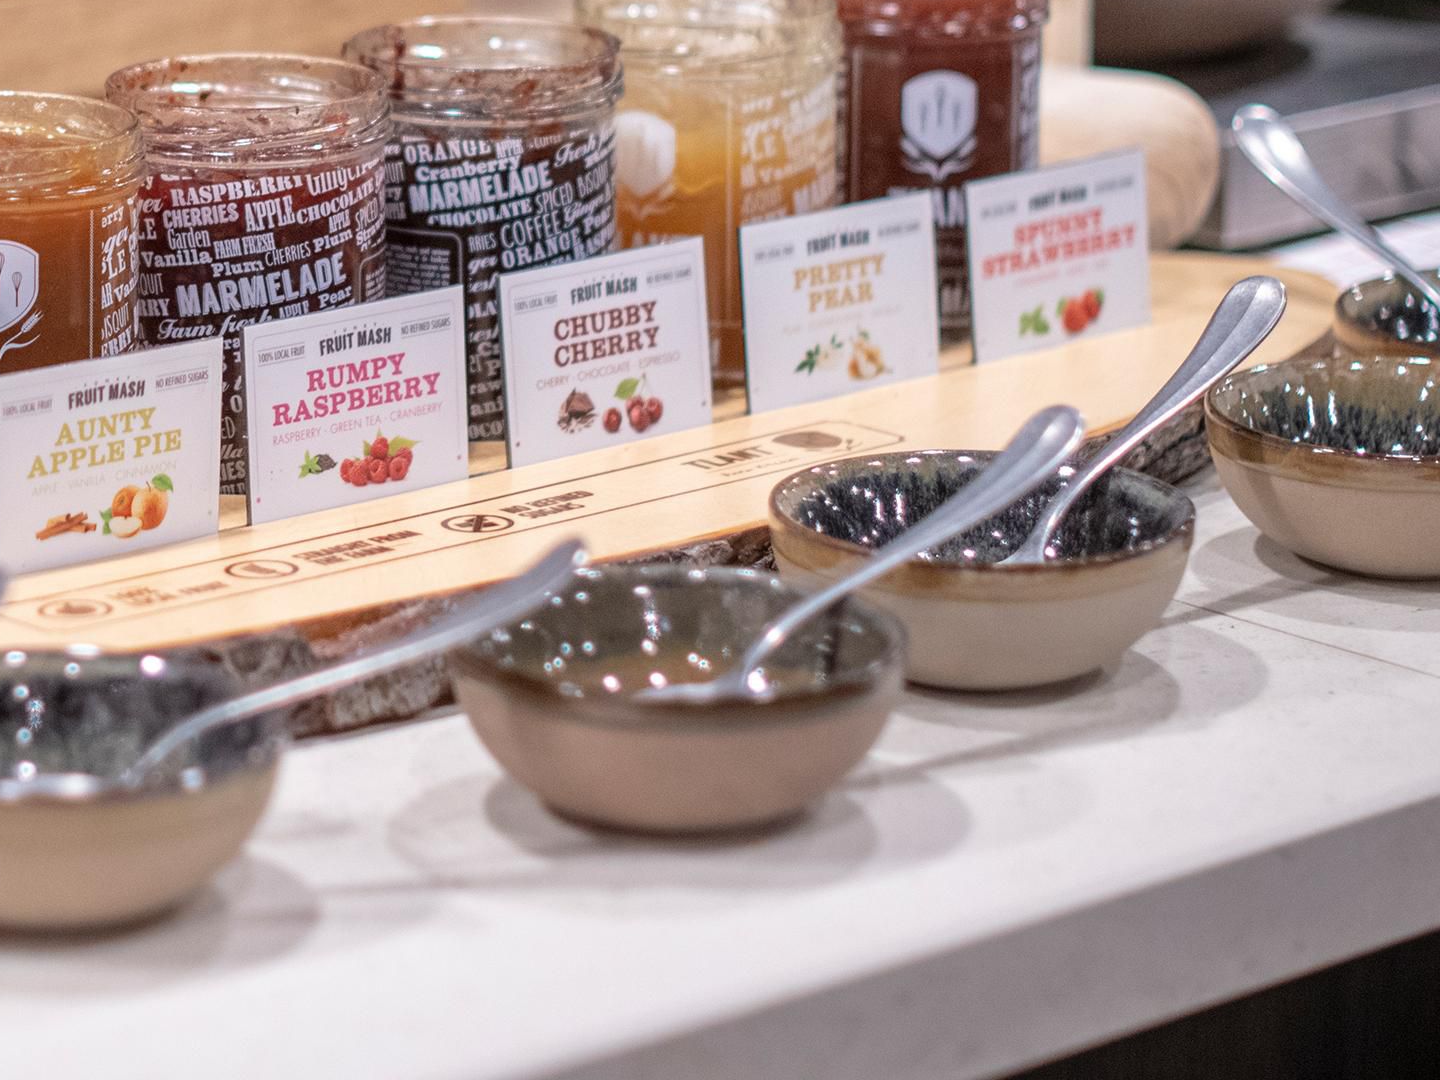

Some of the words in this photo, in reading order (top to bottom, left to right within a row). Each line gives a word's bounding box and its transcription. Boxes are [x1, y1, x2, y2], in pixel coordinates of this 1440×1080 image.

[403, 139, 492, 165] ORANGE
[415, 155, 521, 183] Cranberry
[409, 160, 553, 213] MARMELADE
[535, 181, 574, 214] SPICED
[162, 202, 240, 229] CHERRIES
[244, 195, 296, 233] APPLE
[296, 177, 374, 224] CHOCOLATE
[168, 227, 211, 250] Garden
[214, 240, 241, 259] FARM
[242, 232, 276, 256] FRESH
[500, 211, 562, 249] COFFEE
[141, 249, 213, 267] Vanilla
[211, 259, 264, 277] Plum
[265, 241, 312, 266] CHERRIES
[313, 228, 353, 253] Plum
[982, 223, 1135, 280] STRAWBERRY
[176, 251, 347, 318] MARMELADE
[793, 253, 886, 292] PRETTY
[318, 285, 352, 309] Pear
[570, 282, 603, 305] FRUIT
[605, 276, 638, 297] MASH
[808, 282, 874, 313] PEAR
[553, 300, 658, 341] CHUBBY
[274, 347, 291, 361] LOCAL
[291, 344, 306, 359] FRUIT
[319, 332, 354, 357] FRUIT
[358, 326, 392, 347] MASH
[554, 326, 660, 368] CHERRY
[155, 380, 164, 390] NO
[164, 374, 187, 387] REFINED
[187, 370, 209, 383] SUGARS
[306, 352, 406, 393] RUMPY
[536, 374, 570, 391] CHERRY
[68, 386, 105, 410] FRUIT
[108, 380, 146, 401] MASH
[272, 372, 441, 427] RASPBERRY
[55, 406, 157, 447] AUNTY
[272, 427, 321, 446] RASPBERRY
[330, 418, 361, 434] GREEN
[364, 415, 382, 429] TEA
[390, 402, 443, 422] CRANBERRY
[27, 439, 126, 480] APPLE
[133, 428, 183, 459] PIE
